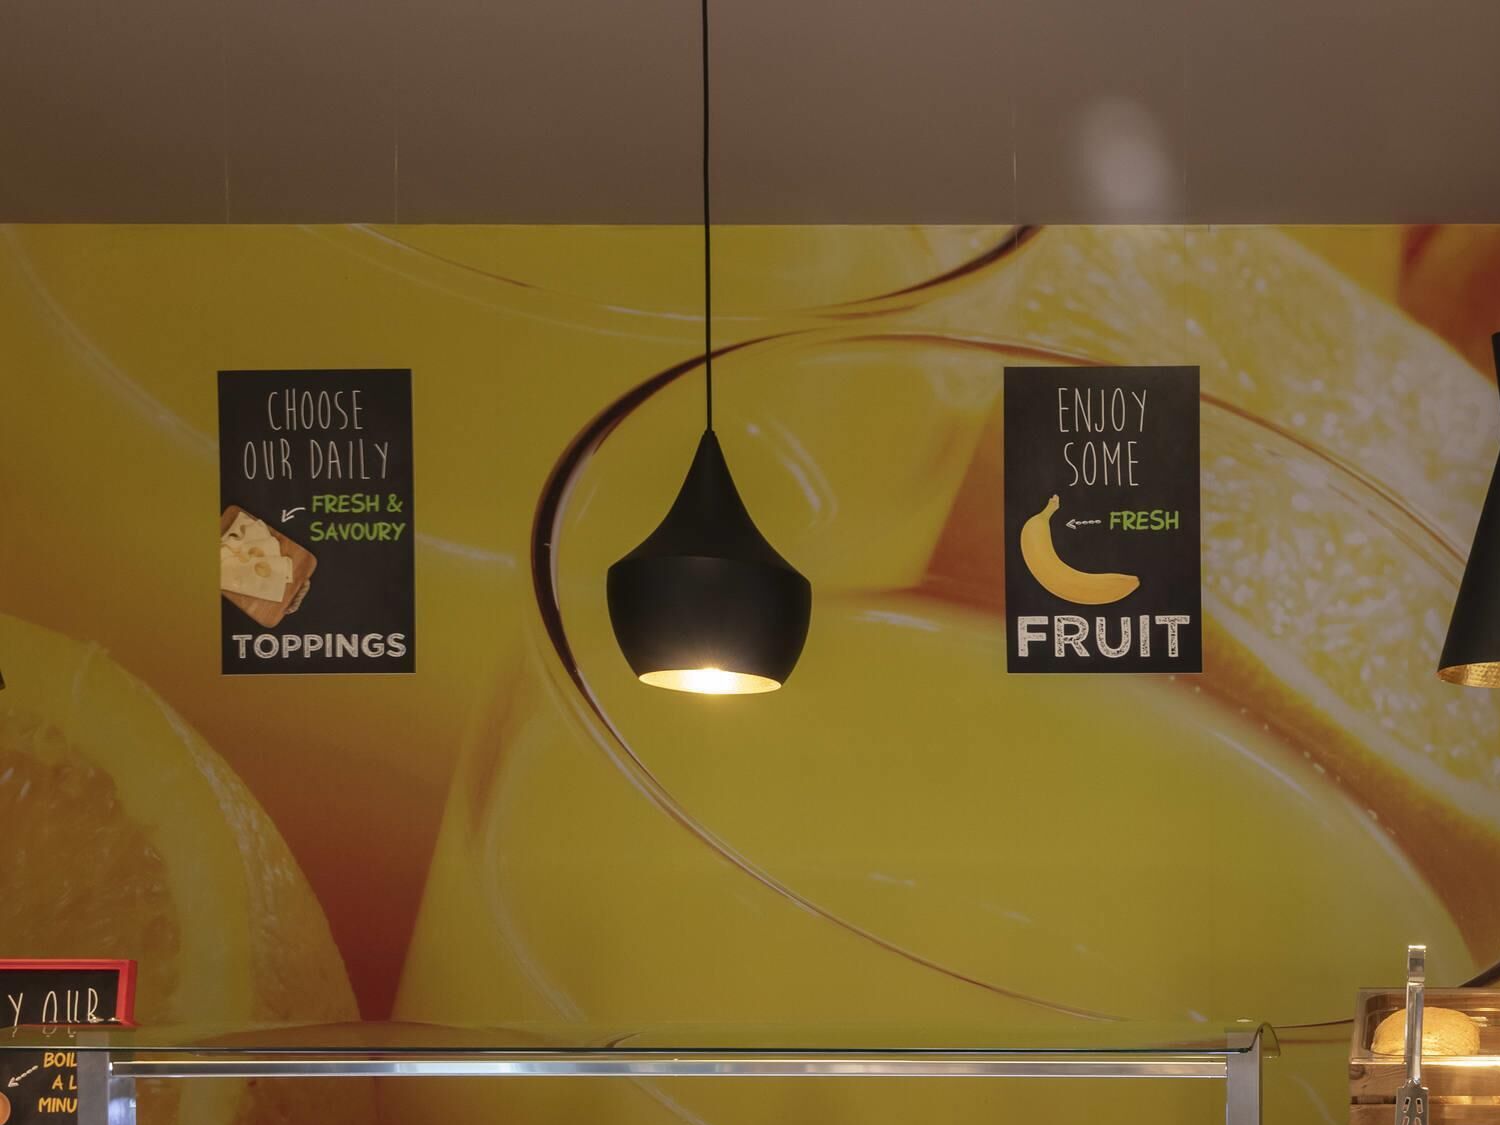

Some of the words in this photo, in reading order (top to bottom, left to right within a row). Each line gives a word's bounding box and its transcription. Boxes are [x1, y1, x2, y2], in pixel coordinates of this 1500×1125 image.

[267, 388, 364, 431] CHOOSE
[1057, 387, 1147, 433] ENJOY
[243, 438, 293, 480] OUR
[309, 439, 389, 480] DAILY
[1063, 441, 1140, 487] SOME
[311, 493, 380, 513] FRESH
[387, 493, 403, 513] &
[309, 521, 407, 542] SAVOURY
[1109, 509, 1180, 531] FRESH
[231, 632, 407, 659] TOPPINGS
[1017, 614, 1191, 659] FRUIT
[42, 987, 100, 1025] OUR
[43, 1052, 78, 1068] BOIL
[69, 1074, 78, 1091] L
[38, 1097, 78, 1114] MINU
